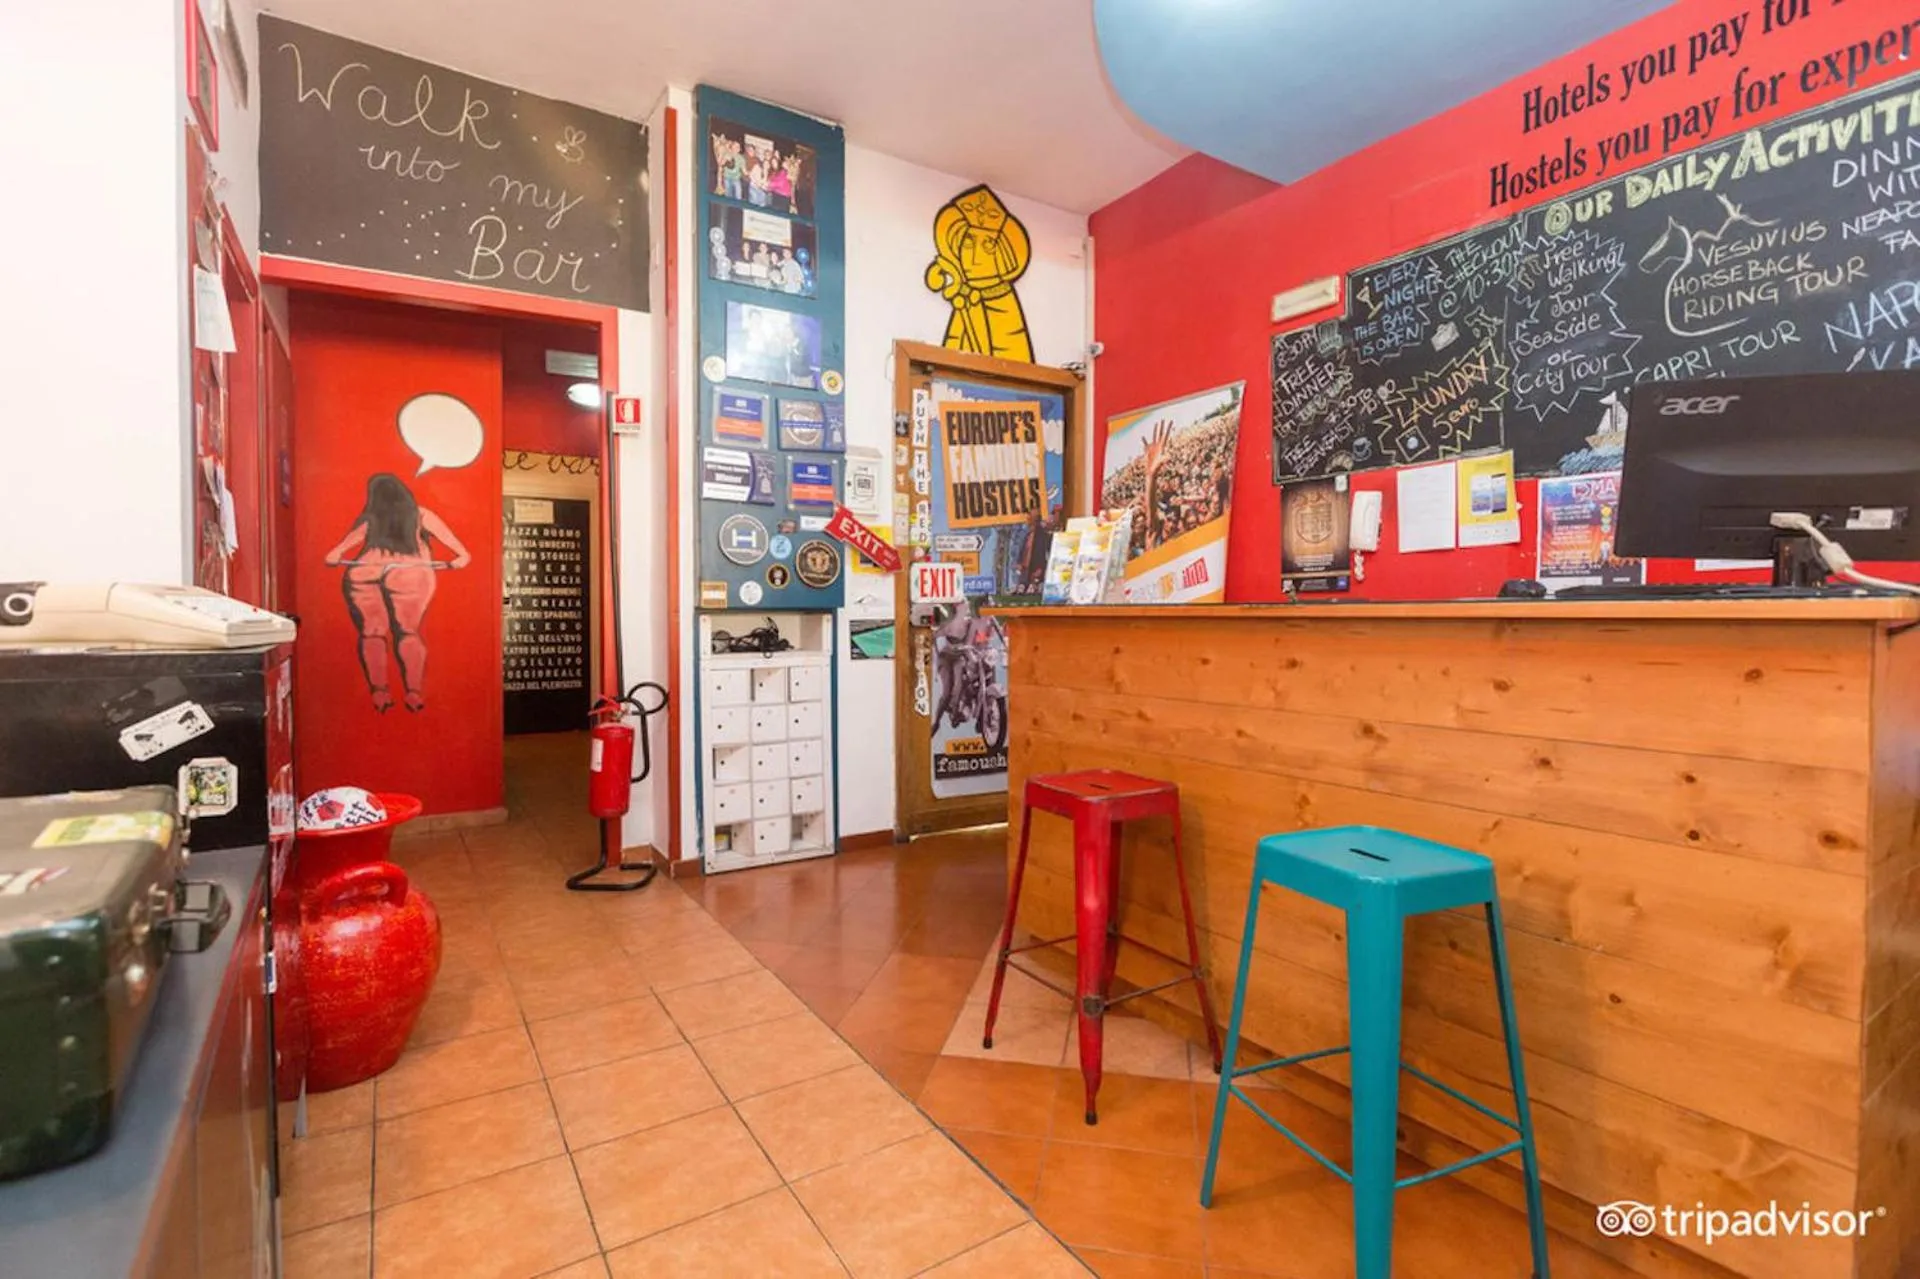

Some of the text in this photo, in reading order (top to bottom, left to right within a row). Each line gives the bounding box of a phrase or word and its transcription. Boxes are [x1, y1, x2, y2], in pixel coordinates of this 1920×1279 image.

[1523, 63, 1610, 134] Hotels
[1620, 53, 1675, 100] you
[1689, 12, 1750, 76] pay
[278, 43, 501, 150] Walk
[1489, 138, 1587, 207] Hostels
[1596, 122, 1650, 176] you
[1662, 96, 1721, 155] pay
[1733, 66, 1786, 120] for
[358, 145, 460, 182] into
[1625, 150, 1731, 209] DAILY
[489, 174, 584, 230] my
[455, 215, 591, 293] Bar
[1444, 238, 1482, 268] THE
[1699, 221, 1828, 267] VESUVIUS
[1373, 257, 1426, 293] EVERY
[1683, 255, 1869, 323] RIDING TOUR
[1375, 323, 1420, 352] OPEN
[1381, 305, 1415, 332] BAR
[1720, 320, 1801, 359] TOUR
[1397, 354, 1489, 429] LAUNDRY
[1660, 395, 1740, 416] acer
[945, 411, 1037, 446] EUROPE'S
[948, 442, 1040, 484] FAMOUS
[952, 477, 1042, 521] HOSTELS
[839, 516, 884, 556] EXIT
[919, 567, 957, 598] EXIT
